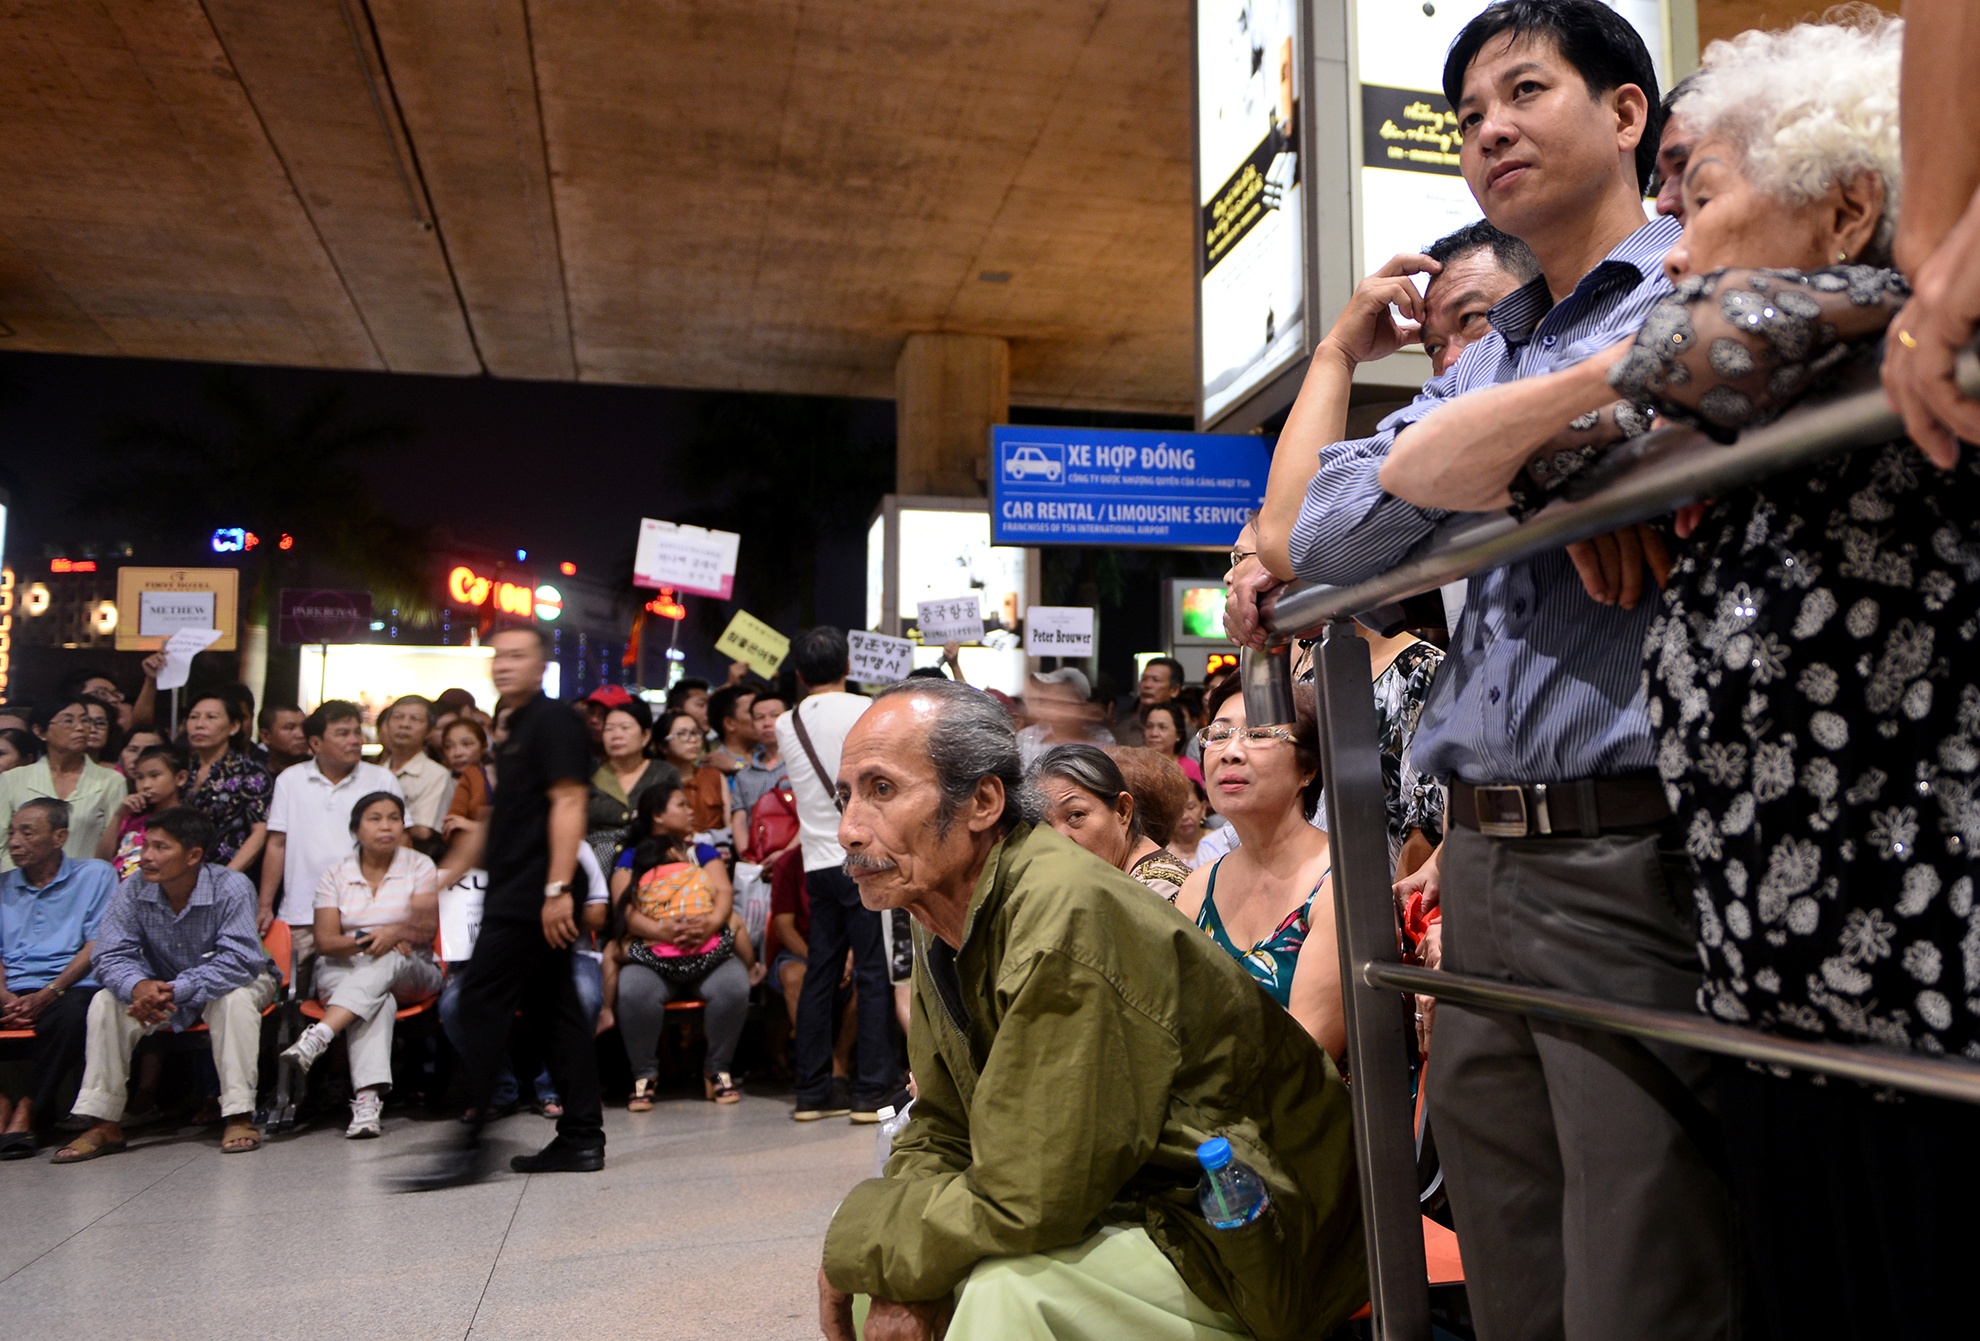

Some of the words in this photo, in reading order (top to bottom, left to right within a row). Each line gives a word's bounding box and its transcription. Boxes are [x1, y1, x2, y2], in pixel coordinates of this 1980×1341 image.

[1068, 444, 1091, 467] XE
[1096, 445, 1137, 474] HỢP
[1141, 442, 1195, 471] ĐỒNG
[1003, 501, 1034, 519] CAR
[1037, 502, 1095, 521] RENTAL
[1097, 503, 1106, 522] /
[1108, 503, 1190, 523] LIMOUSINE
[1003, 521, 1050, 532] FRANCHISES
[1050, 523, 1060, 533] OF
[1078, 523, 1136, 534] INTERNATIONAL
[1137, 525, 1169, 534] AIRPORT
[921, 601, 977, 623] 중국항공
[1033, 628, 1054, 643] Peter
[1056, 629, 1092, 644] Brouwer
[854, 654, 900, 673] 여행사
